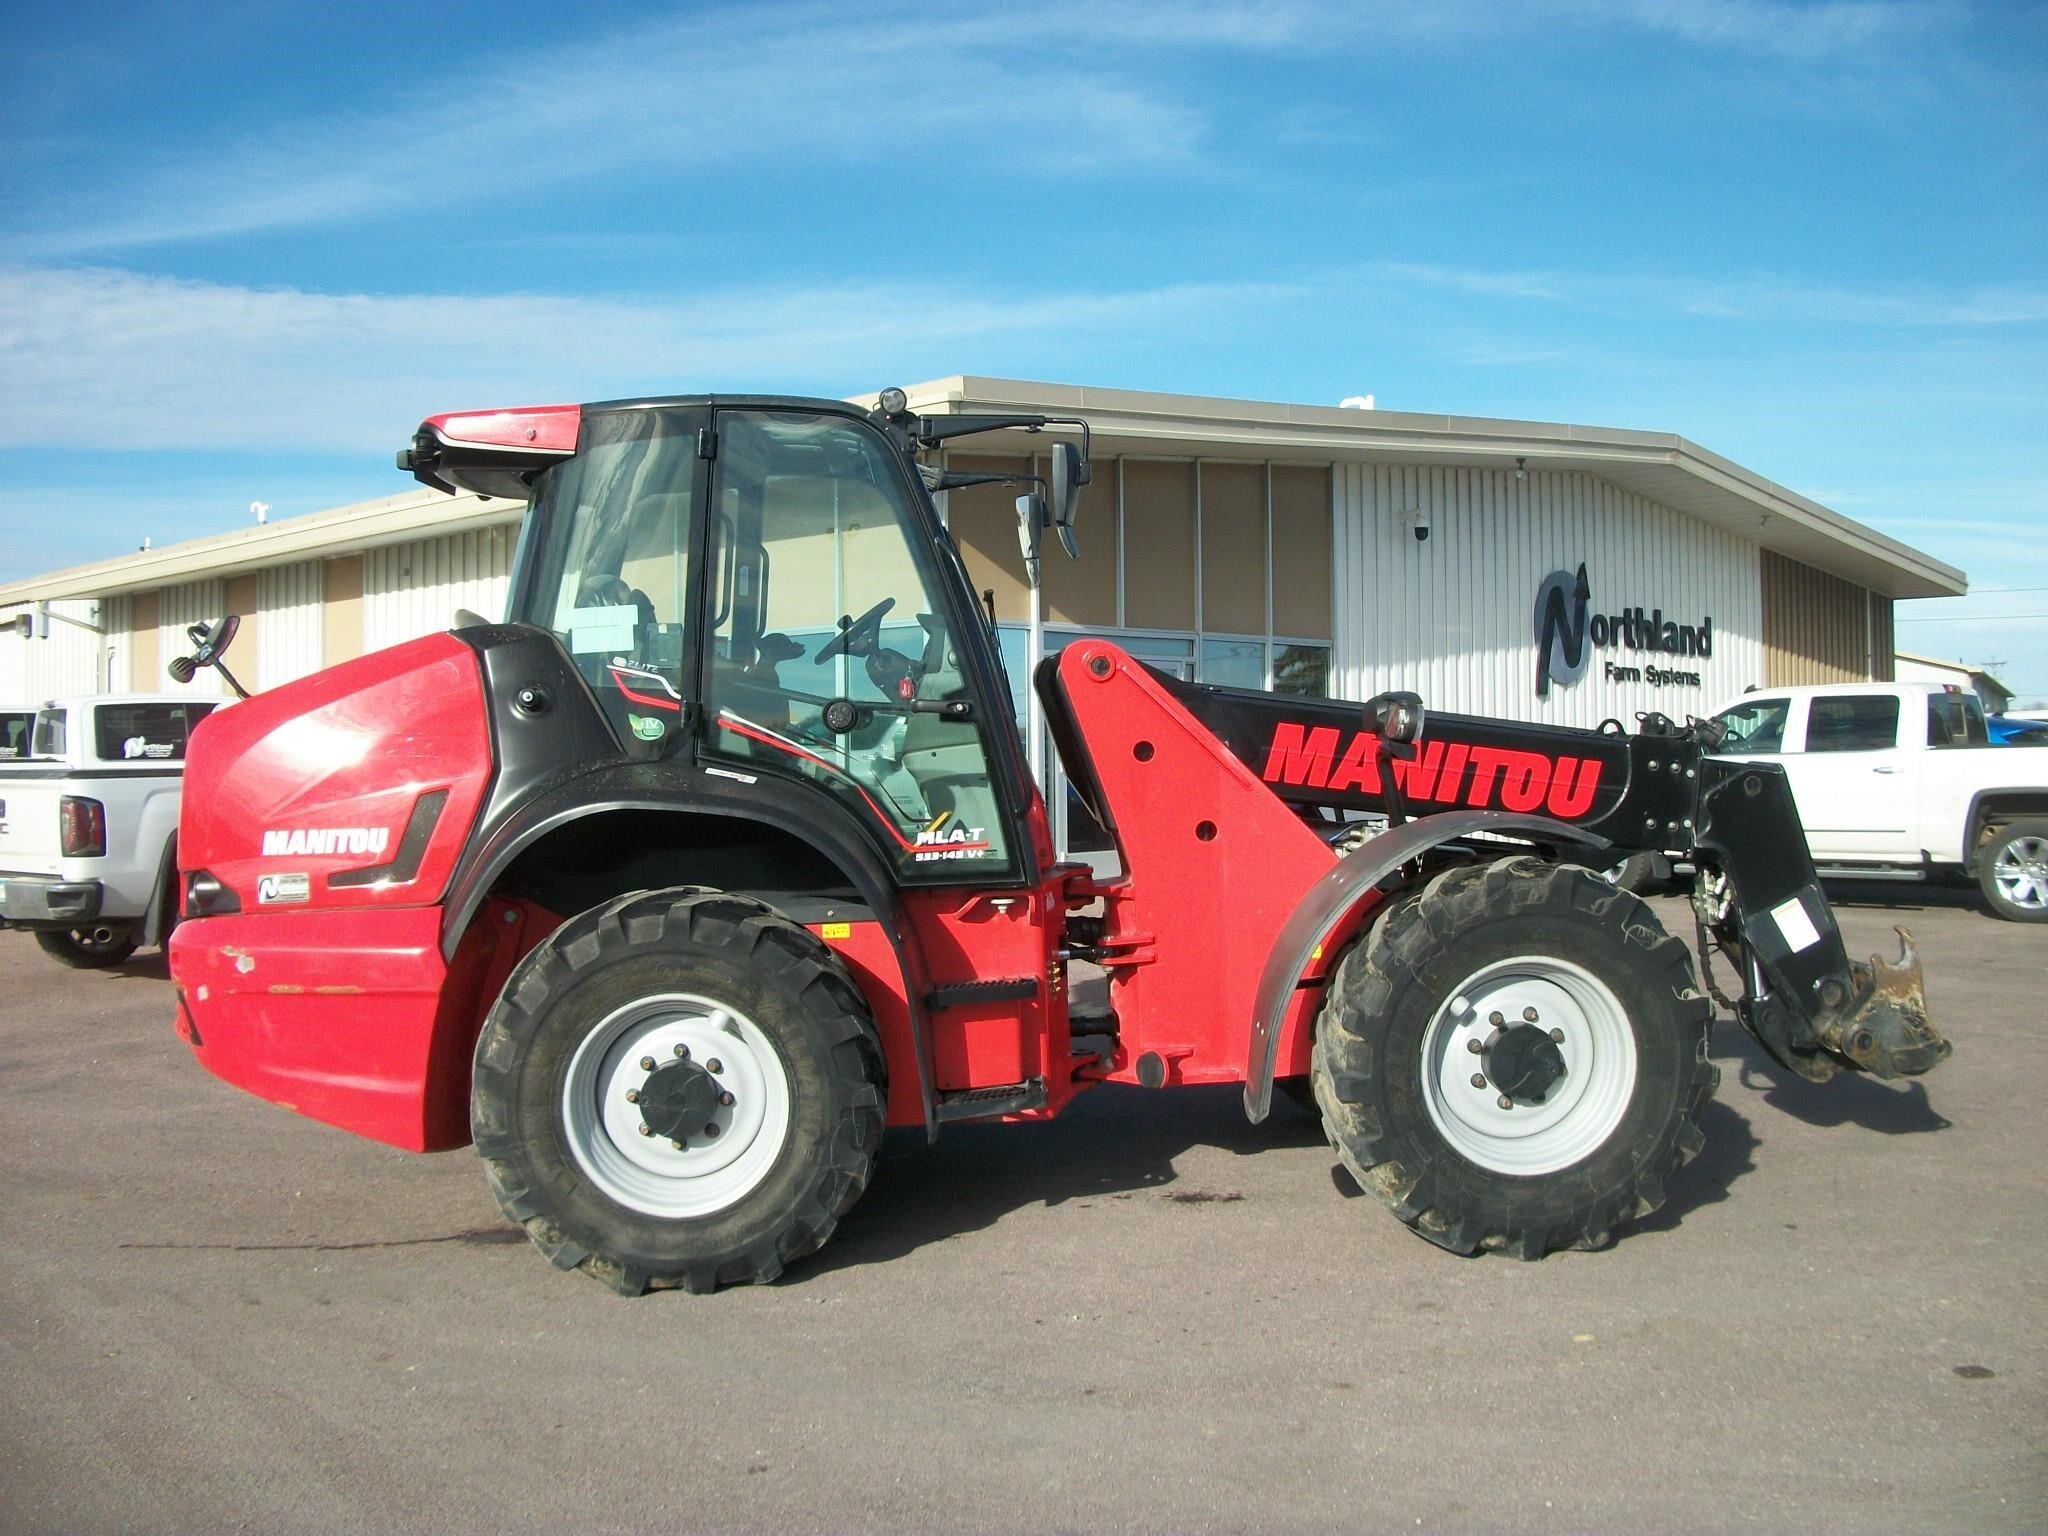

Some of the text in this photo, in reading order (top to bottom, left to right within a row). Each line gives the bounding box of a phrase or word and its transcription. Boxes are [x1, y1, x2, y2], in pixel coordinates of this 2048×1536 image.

[1535, 562, 1712, 697] Northland
[1605, 662, 1701, 688] Farm Systems
[1263, 722, 1602, 818] MANITOU
[262, 827, 389, 856] MANITOU
[917, 828, 984, 846] MLA-T
